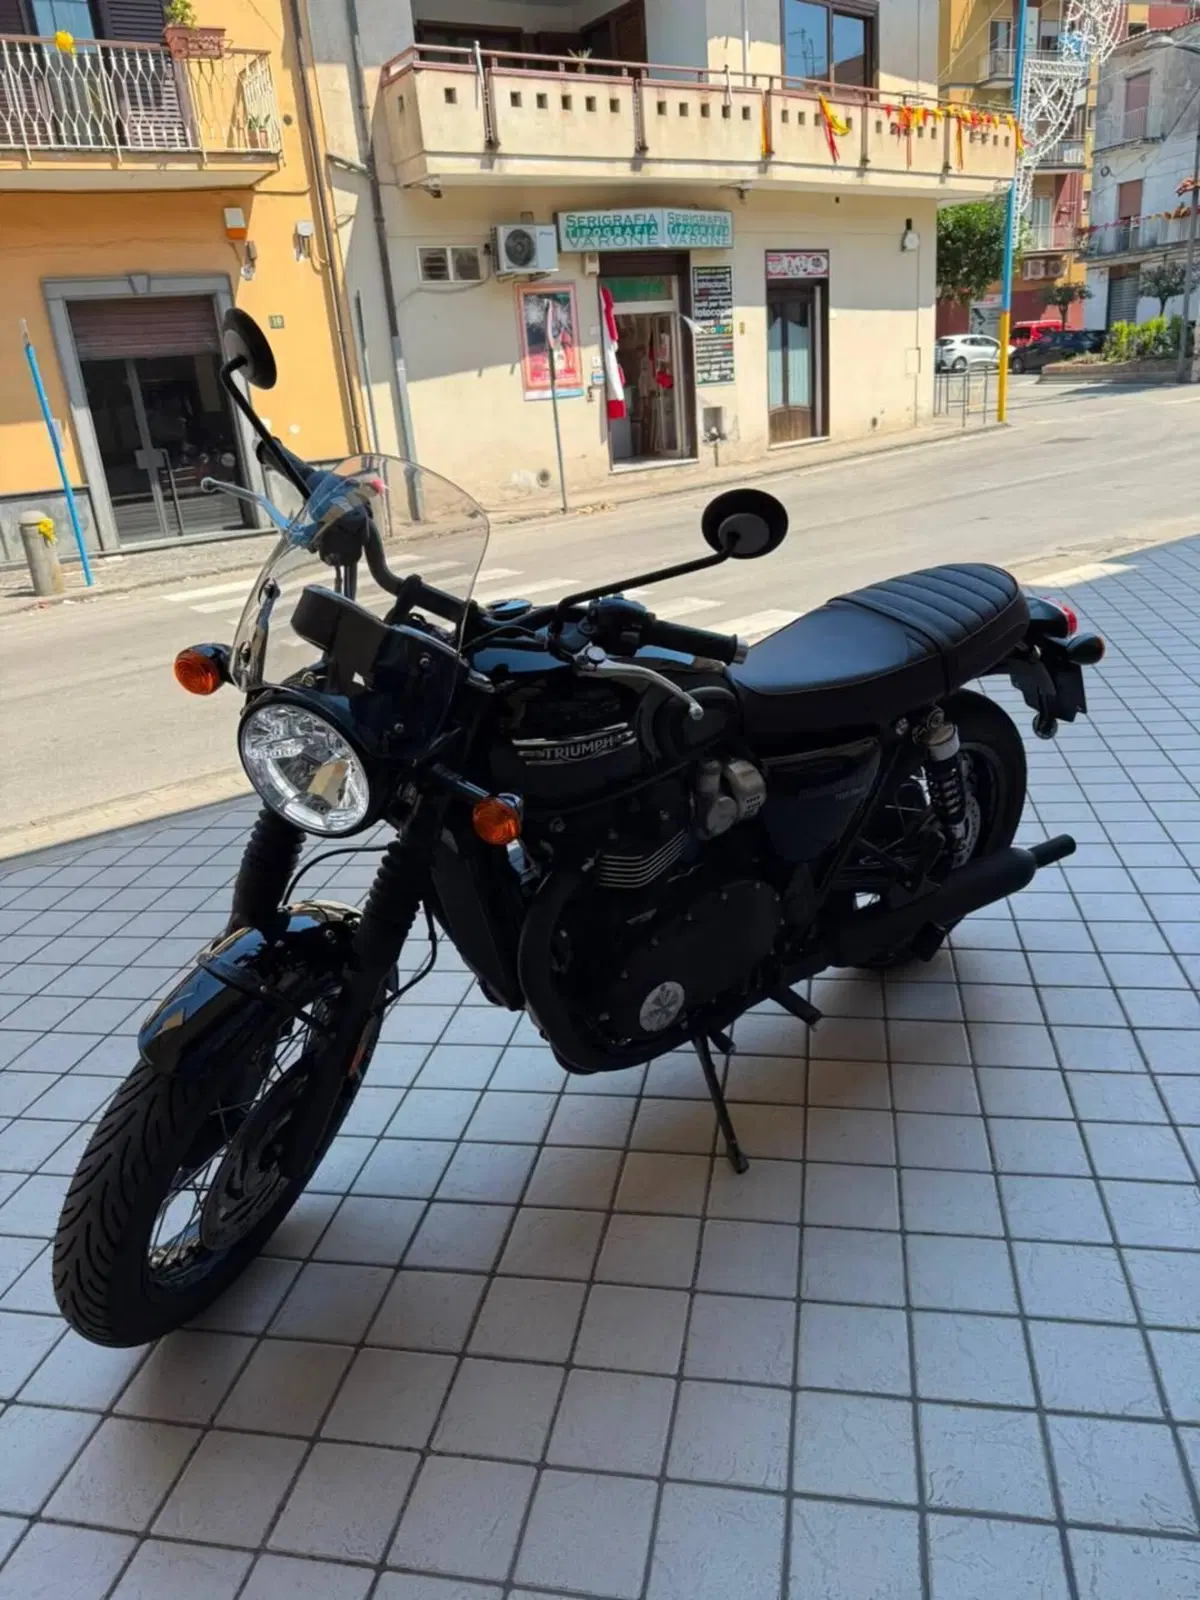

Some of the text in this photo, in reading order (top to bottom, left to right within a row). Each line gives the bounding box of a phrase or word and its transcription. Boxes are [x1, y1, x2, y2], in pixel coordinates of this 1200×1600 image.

[567, 226, 658, 237] TIPOGRAFIA
[667, 224, 729, 236] TIPOGRAFIA
[567, 235, 659, 248] VARONE
[668, 234, 729, 246] VARONE
[543, 736, 613, 760] TRIUMPH
